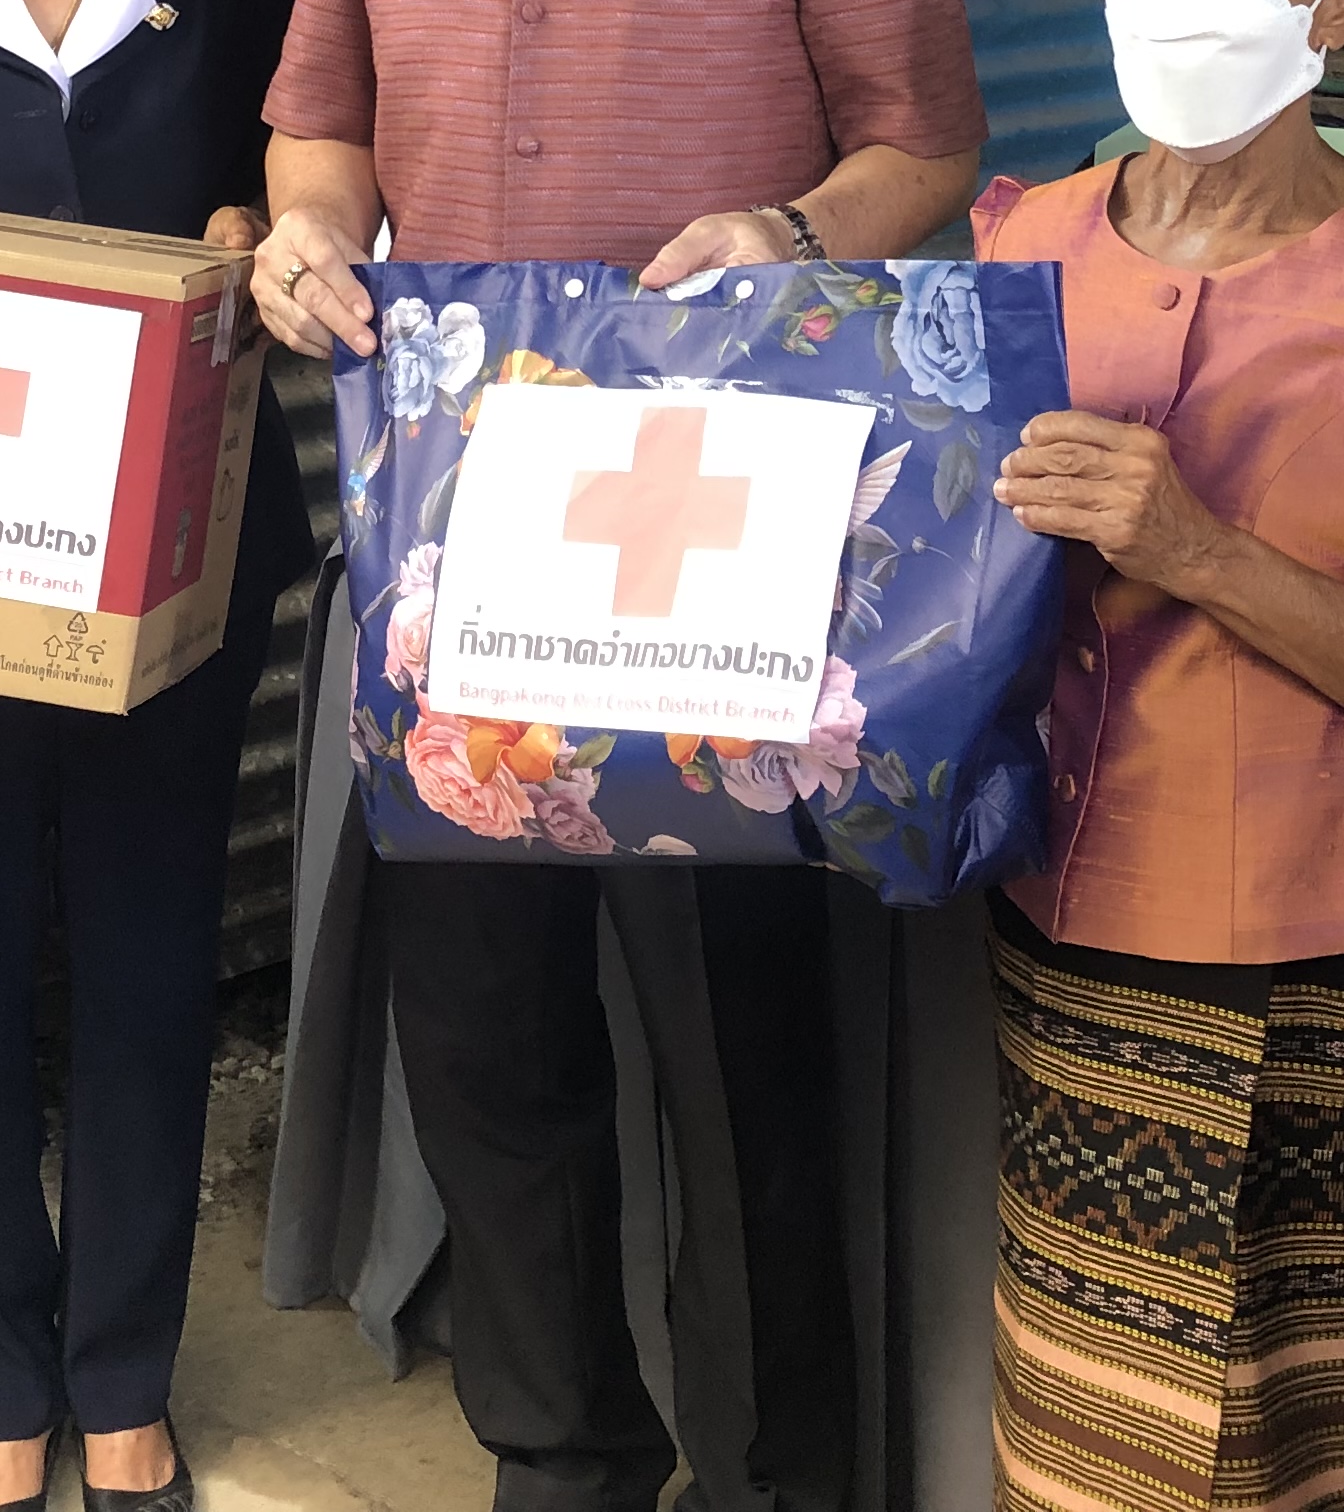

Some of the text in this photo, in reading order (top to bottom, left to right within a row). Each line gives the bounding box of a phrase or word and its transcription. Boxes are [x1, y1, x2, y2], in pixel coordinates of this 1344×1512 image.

[19, 570, 84, 594] Branch
[458, 604, 814, 683] กิ่งกาชาดอำเภอบางปะกง
[459, 681, 566, 711] Bangpakong
[658, 695, 719, 717] District
[725, 699, 796, 724] Branch
